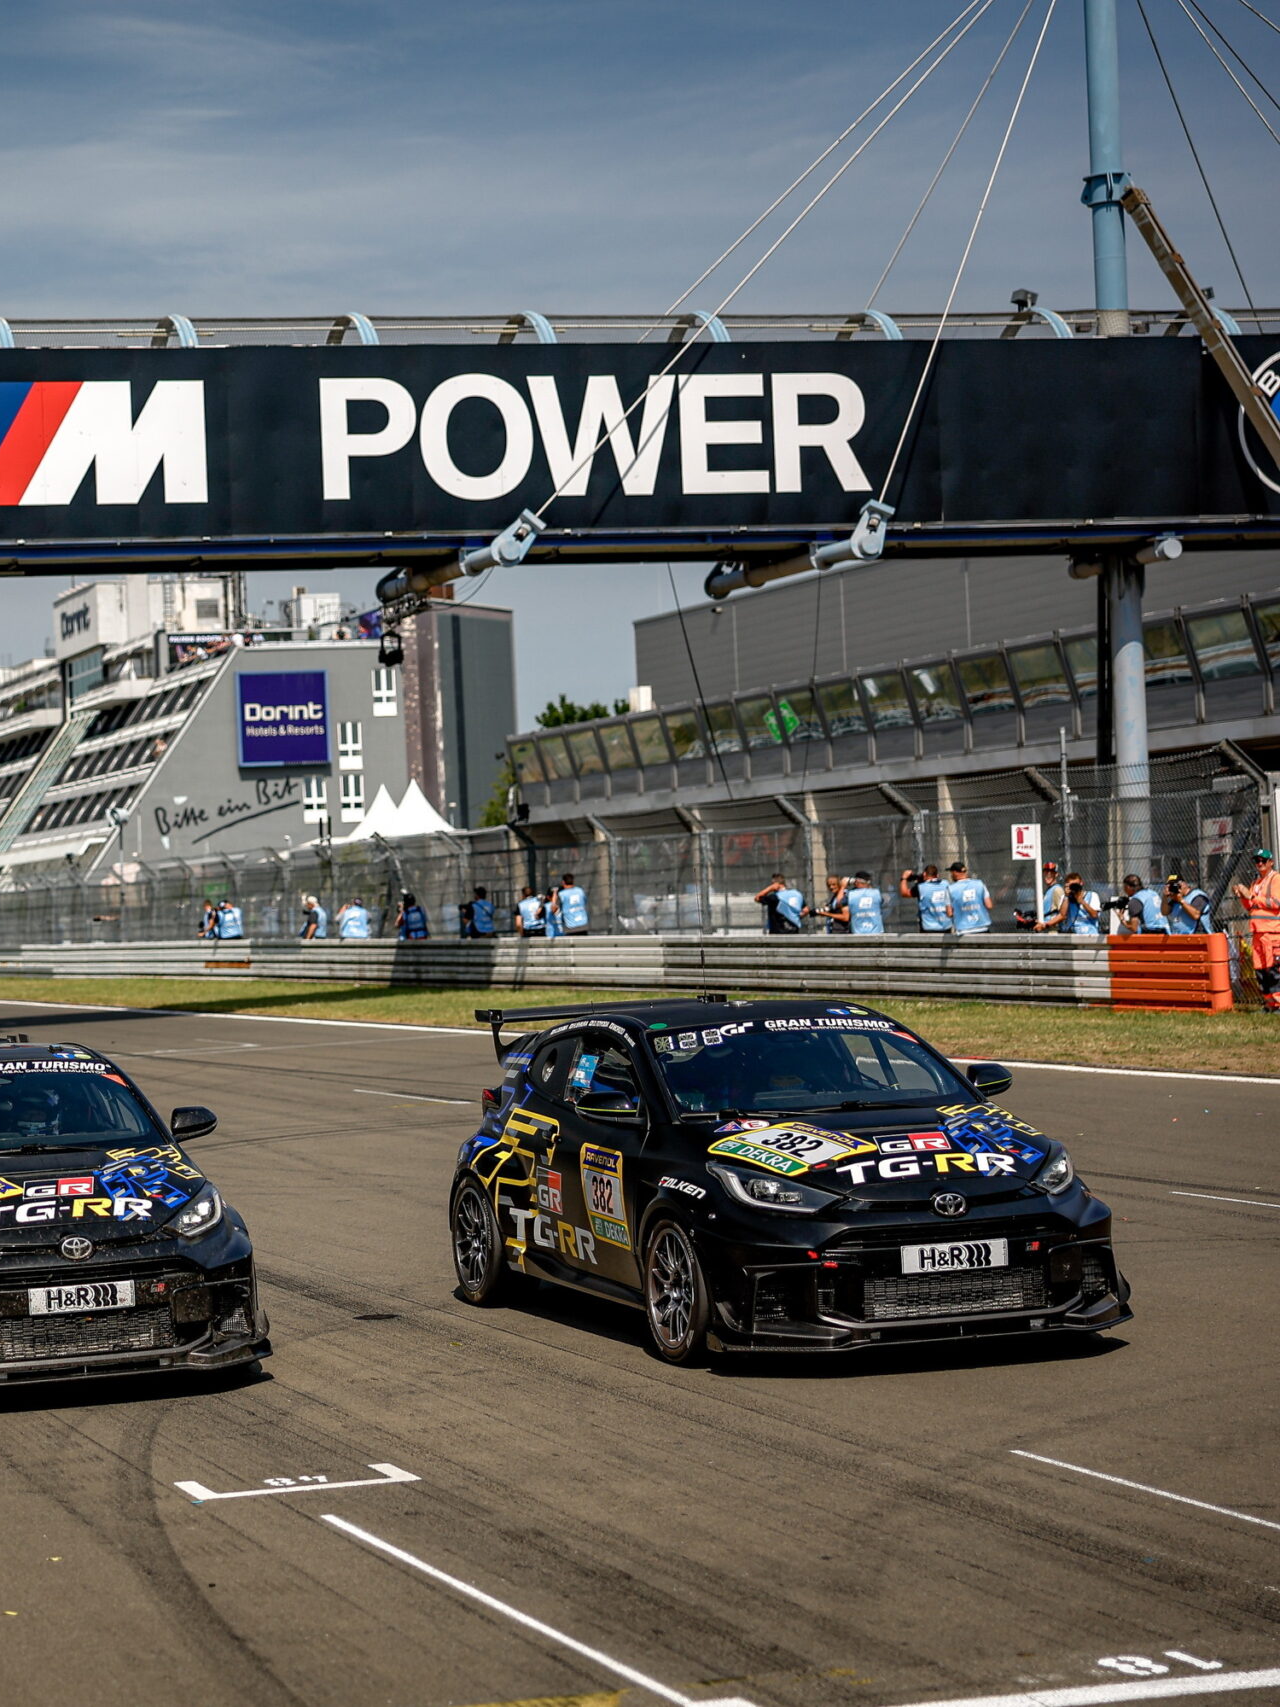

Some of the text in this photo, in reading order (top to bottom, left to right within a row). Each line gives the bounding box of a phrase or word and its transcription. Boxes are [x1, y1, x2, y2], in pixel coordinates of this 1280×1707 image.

[18, 371, 873, 504] M POWER
[243, 701, 324, 722] Dorint
[246, 724, 325, 737] Hotels & Resorts
[154, 776, 299, 836] Bitte ein Bit
[764, 1018, 811, 1029] GRAN
[761, 1132, 824, 1158] 382
[792, 1124, 857, 1147] RAVENOL
[881, 1138, 949, 1152] GR
[585, 1151, 616, 1169] RAVENOL
[738, 1144, 794, 1172] DEKRA
[836, 1153, 1018, 1185] TG-RR
[26, 1182, 92, 1197] GR
[537, 1184, 562, 1213] GR
[591, 1175, 614, 1215] 382
[658, 1176, 707, 1200] FALKEN
[509, 1207, 598, 1265] TG-RR
[604, 1220, 629, 1244] DEKRA
[919, 1245, 965, 1270] H&R
[45, 1286, 92, 1311] H&R
[1097, 1651, 1223, 1676] 18
